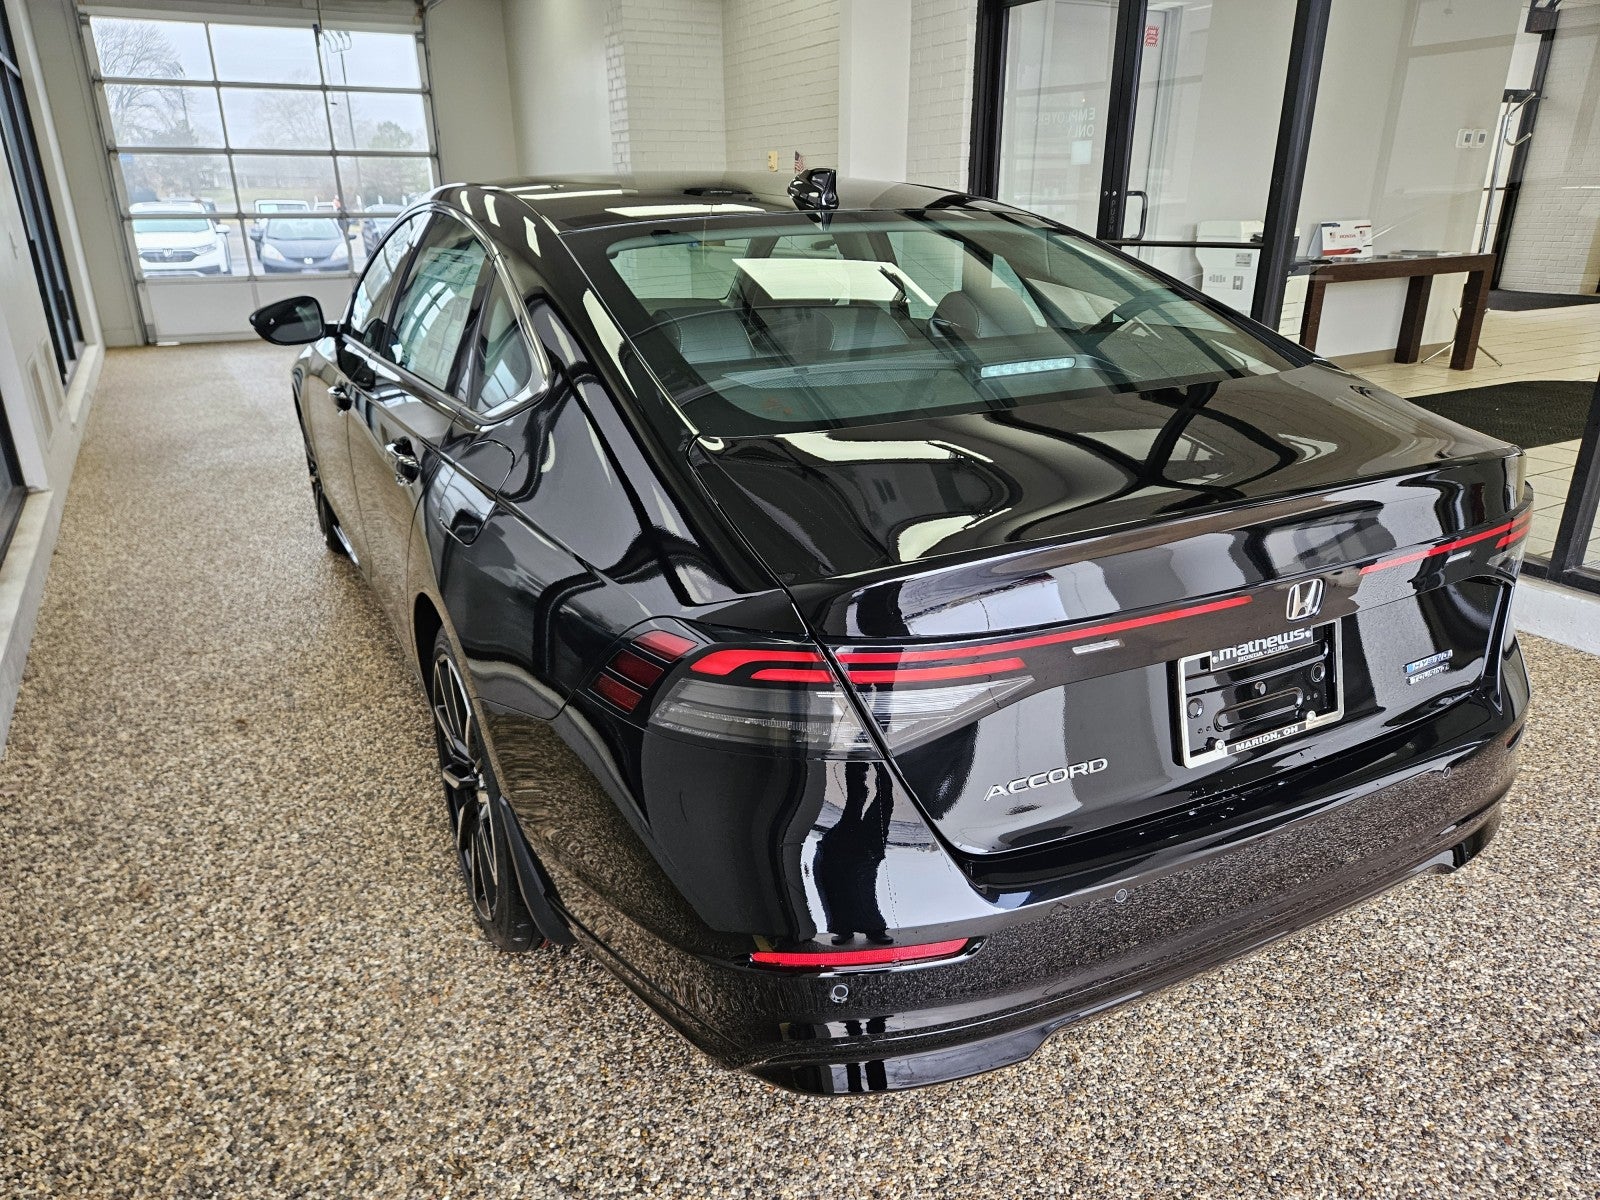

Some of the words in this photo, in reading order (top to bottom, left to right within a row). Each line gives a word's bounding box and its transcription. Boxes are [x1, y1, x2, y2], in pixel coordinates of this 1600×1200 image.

[1237, 652, 1264, 662] HONDA
[1267, 644, 1289, 655] ACURA
[1235, 732, 1281, 752] MARION,
[1283, 725, 1299, 736] OH
[984, 758, 1109, 802] ACCORD
